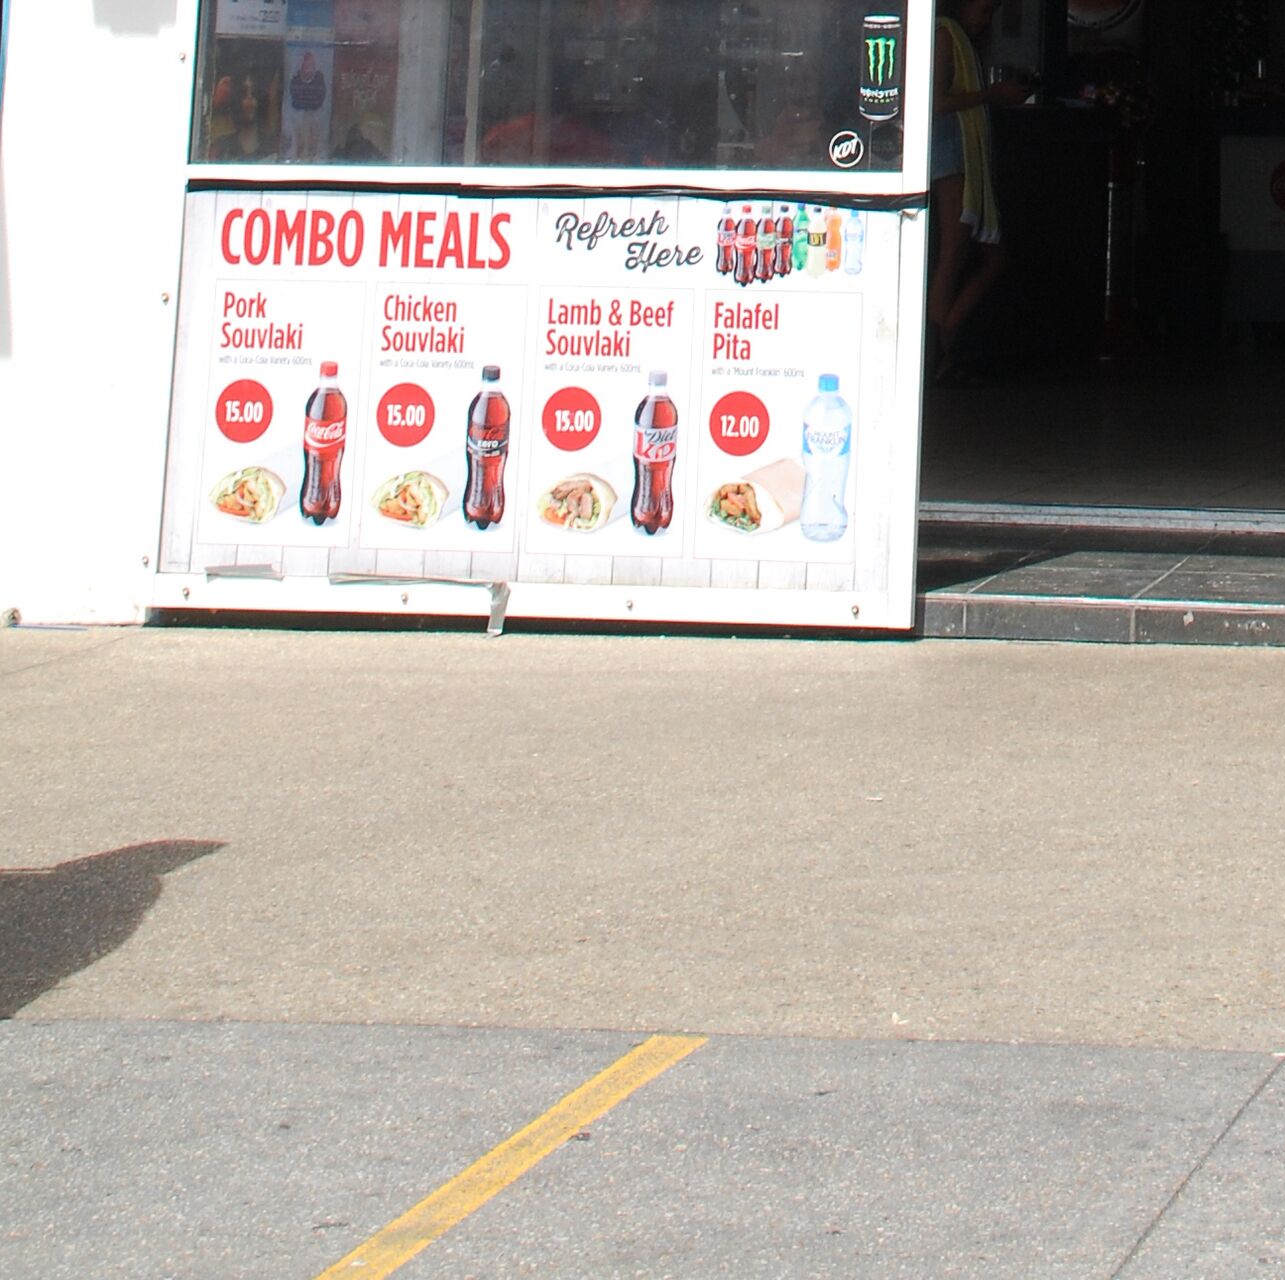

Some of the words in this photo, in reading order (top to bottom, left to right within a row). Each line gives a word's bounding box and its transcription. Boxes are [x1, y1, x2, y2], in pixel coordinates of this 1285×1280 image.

[220, 208, 365, 268] COMBO
[378, 209, 512, 271] MEALS
[556, 210, 670, 252] Refresh
[624, 241, 705, 274] Here
[223, 291, 267, 319] Pork
[383, 294, 458, 323] Chicken
[547, 297, 602, 326] Lamb
[608, 299, 623, 326] &
[629, 300, 675, 328] Beef
[713, 301, 780, 330] Falafel
[220, 322, 304, 351] Souvlaki
[381, 325, 466, 354] Souvlaki
[546, 329, 631, 358] Souvlaki
[712, 332, 752, 361] Pita
[224, 400, 264, 424] 15.00
[386, 403, 426, 427] 15.00
[555, 409, 595, 433] 15.00
[720, 415, 760, 438] 12.00
